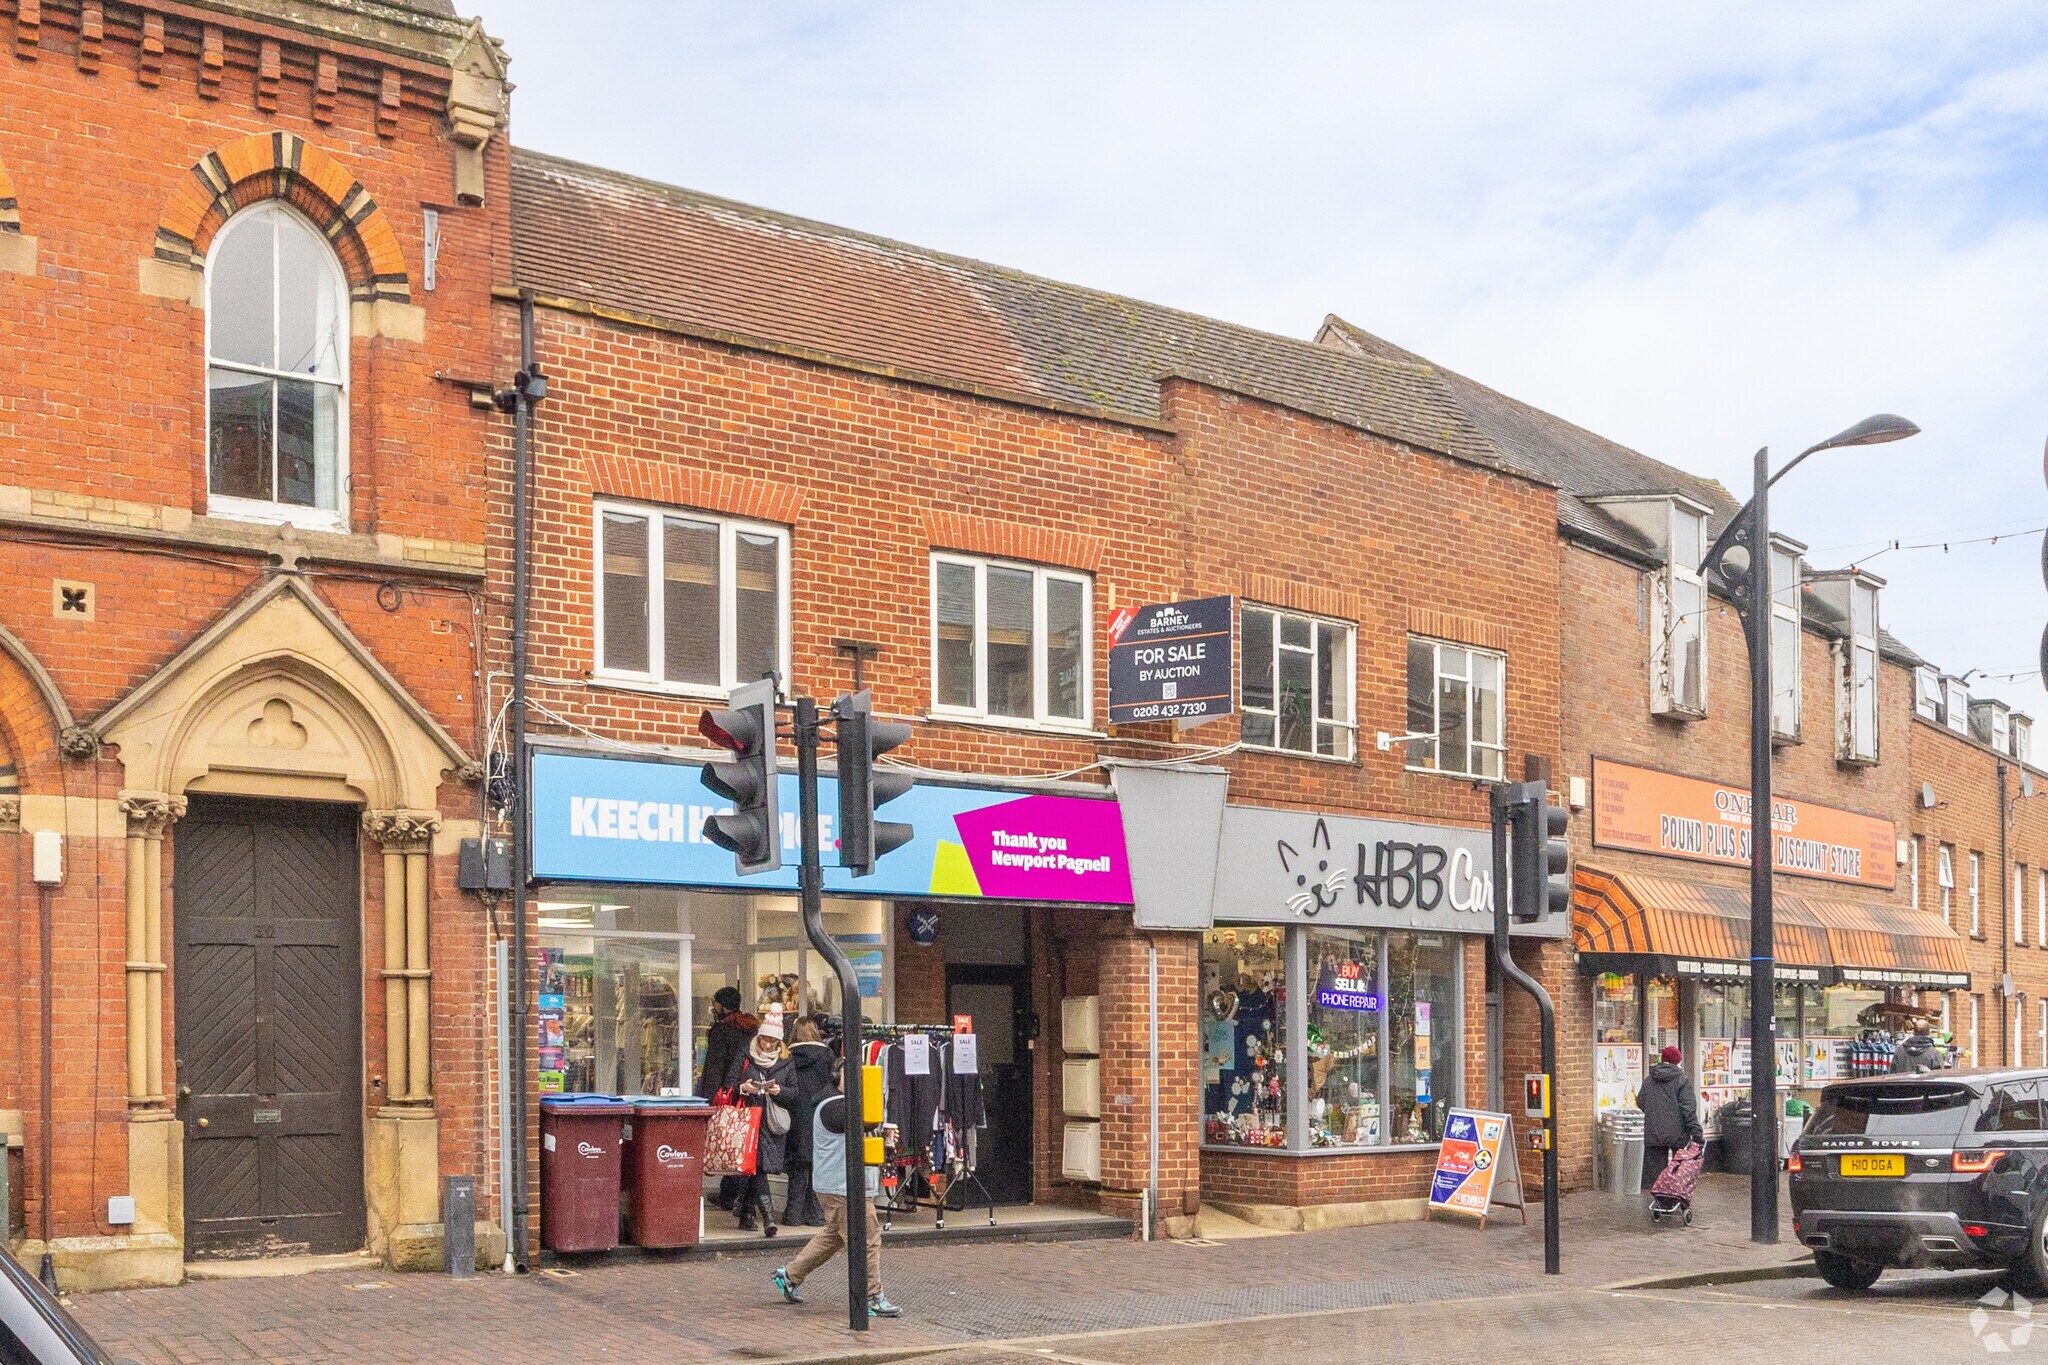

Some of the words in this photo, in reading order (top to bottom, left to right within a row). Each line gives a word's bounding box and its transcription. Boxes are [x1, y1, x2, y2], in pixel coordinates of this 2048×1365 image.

[1150, 615, 1189, 628] BARNEY
[1166, 623, 1202, 632] AUCTIONEERS
[1134, 648, 1164, 665] FOR
[1168, 643, 1206, 662] SALE
[1140, 670, 1153, 682] BY
[1154, 665, 1200, 679] AUCTION
[1133, 705, 1159, 717] 0208
[1161, 704, 1179, 716] 432
[1182, 702, 1206, 715] 7330
[570, 797, 684, 842] KEECH
[1780, 824, 1792, 832] LTD
[992, 830, 1038, 848] Thank
[1038, 836, 1067, 853] you
[1661, 814, 1702, 853] POUND
[1706, 822, 1736, 858] PLUS
[1777, 835, 1828, 873] DISCOUNT
[1830, 845, 1861, 878] STORE
[992, 850, 1056, 871] Newport
[1058, 854, 1110, 874] Pagnell
[1354, 840, 1447, 911] HBB
[1342, 966, 1359, 978] BUY
[1335, 978, 1357, 991] SELL
[1357, 981, 1365, 992] &
[1321, 993, 1348, 1006] PHONE
[1350, 996, 1377, 1009] REPAIR
[1627, 1048, 1639, 1060] DIY
